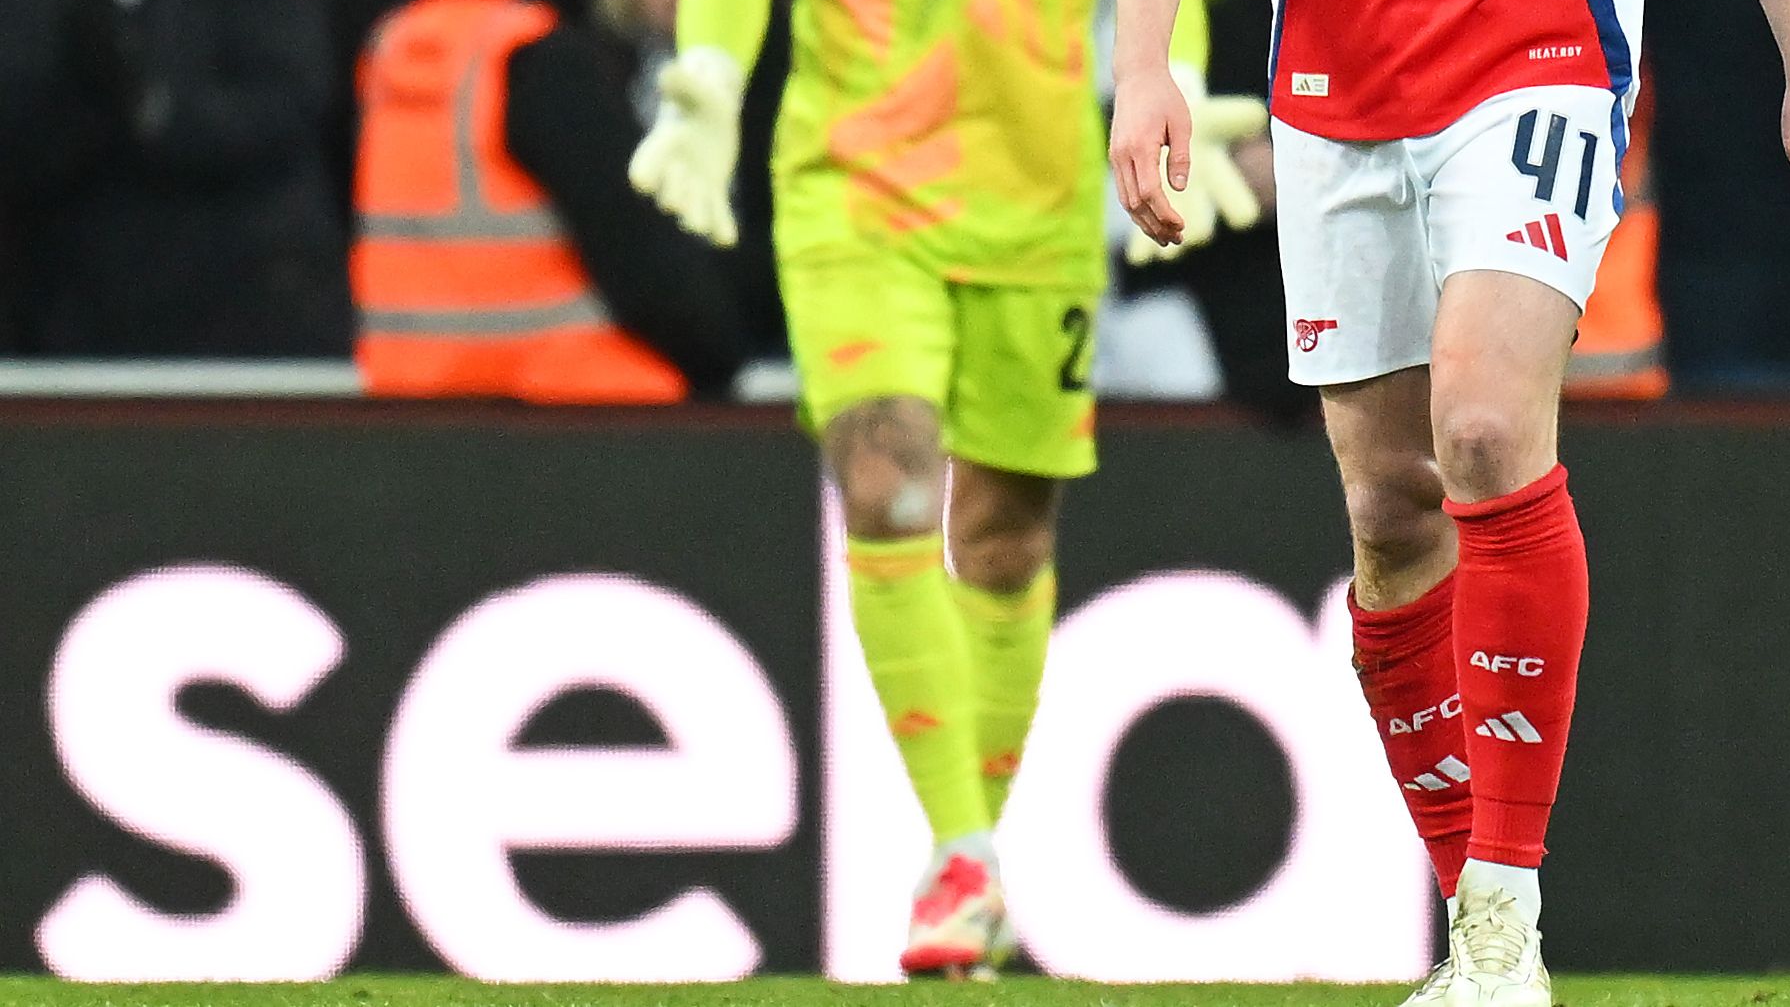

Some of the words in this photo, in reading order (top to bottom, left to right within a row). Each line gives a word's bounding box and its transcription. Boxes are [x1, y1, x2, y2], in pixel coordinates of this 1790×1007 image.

[1510, 108, 1599, 222] 41
[1470, 650, 1545, 678] AFC
[1389, 692, 1464, 736] AFC
